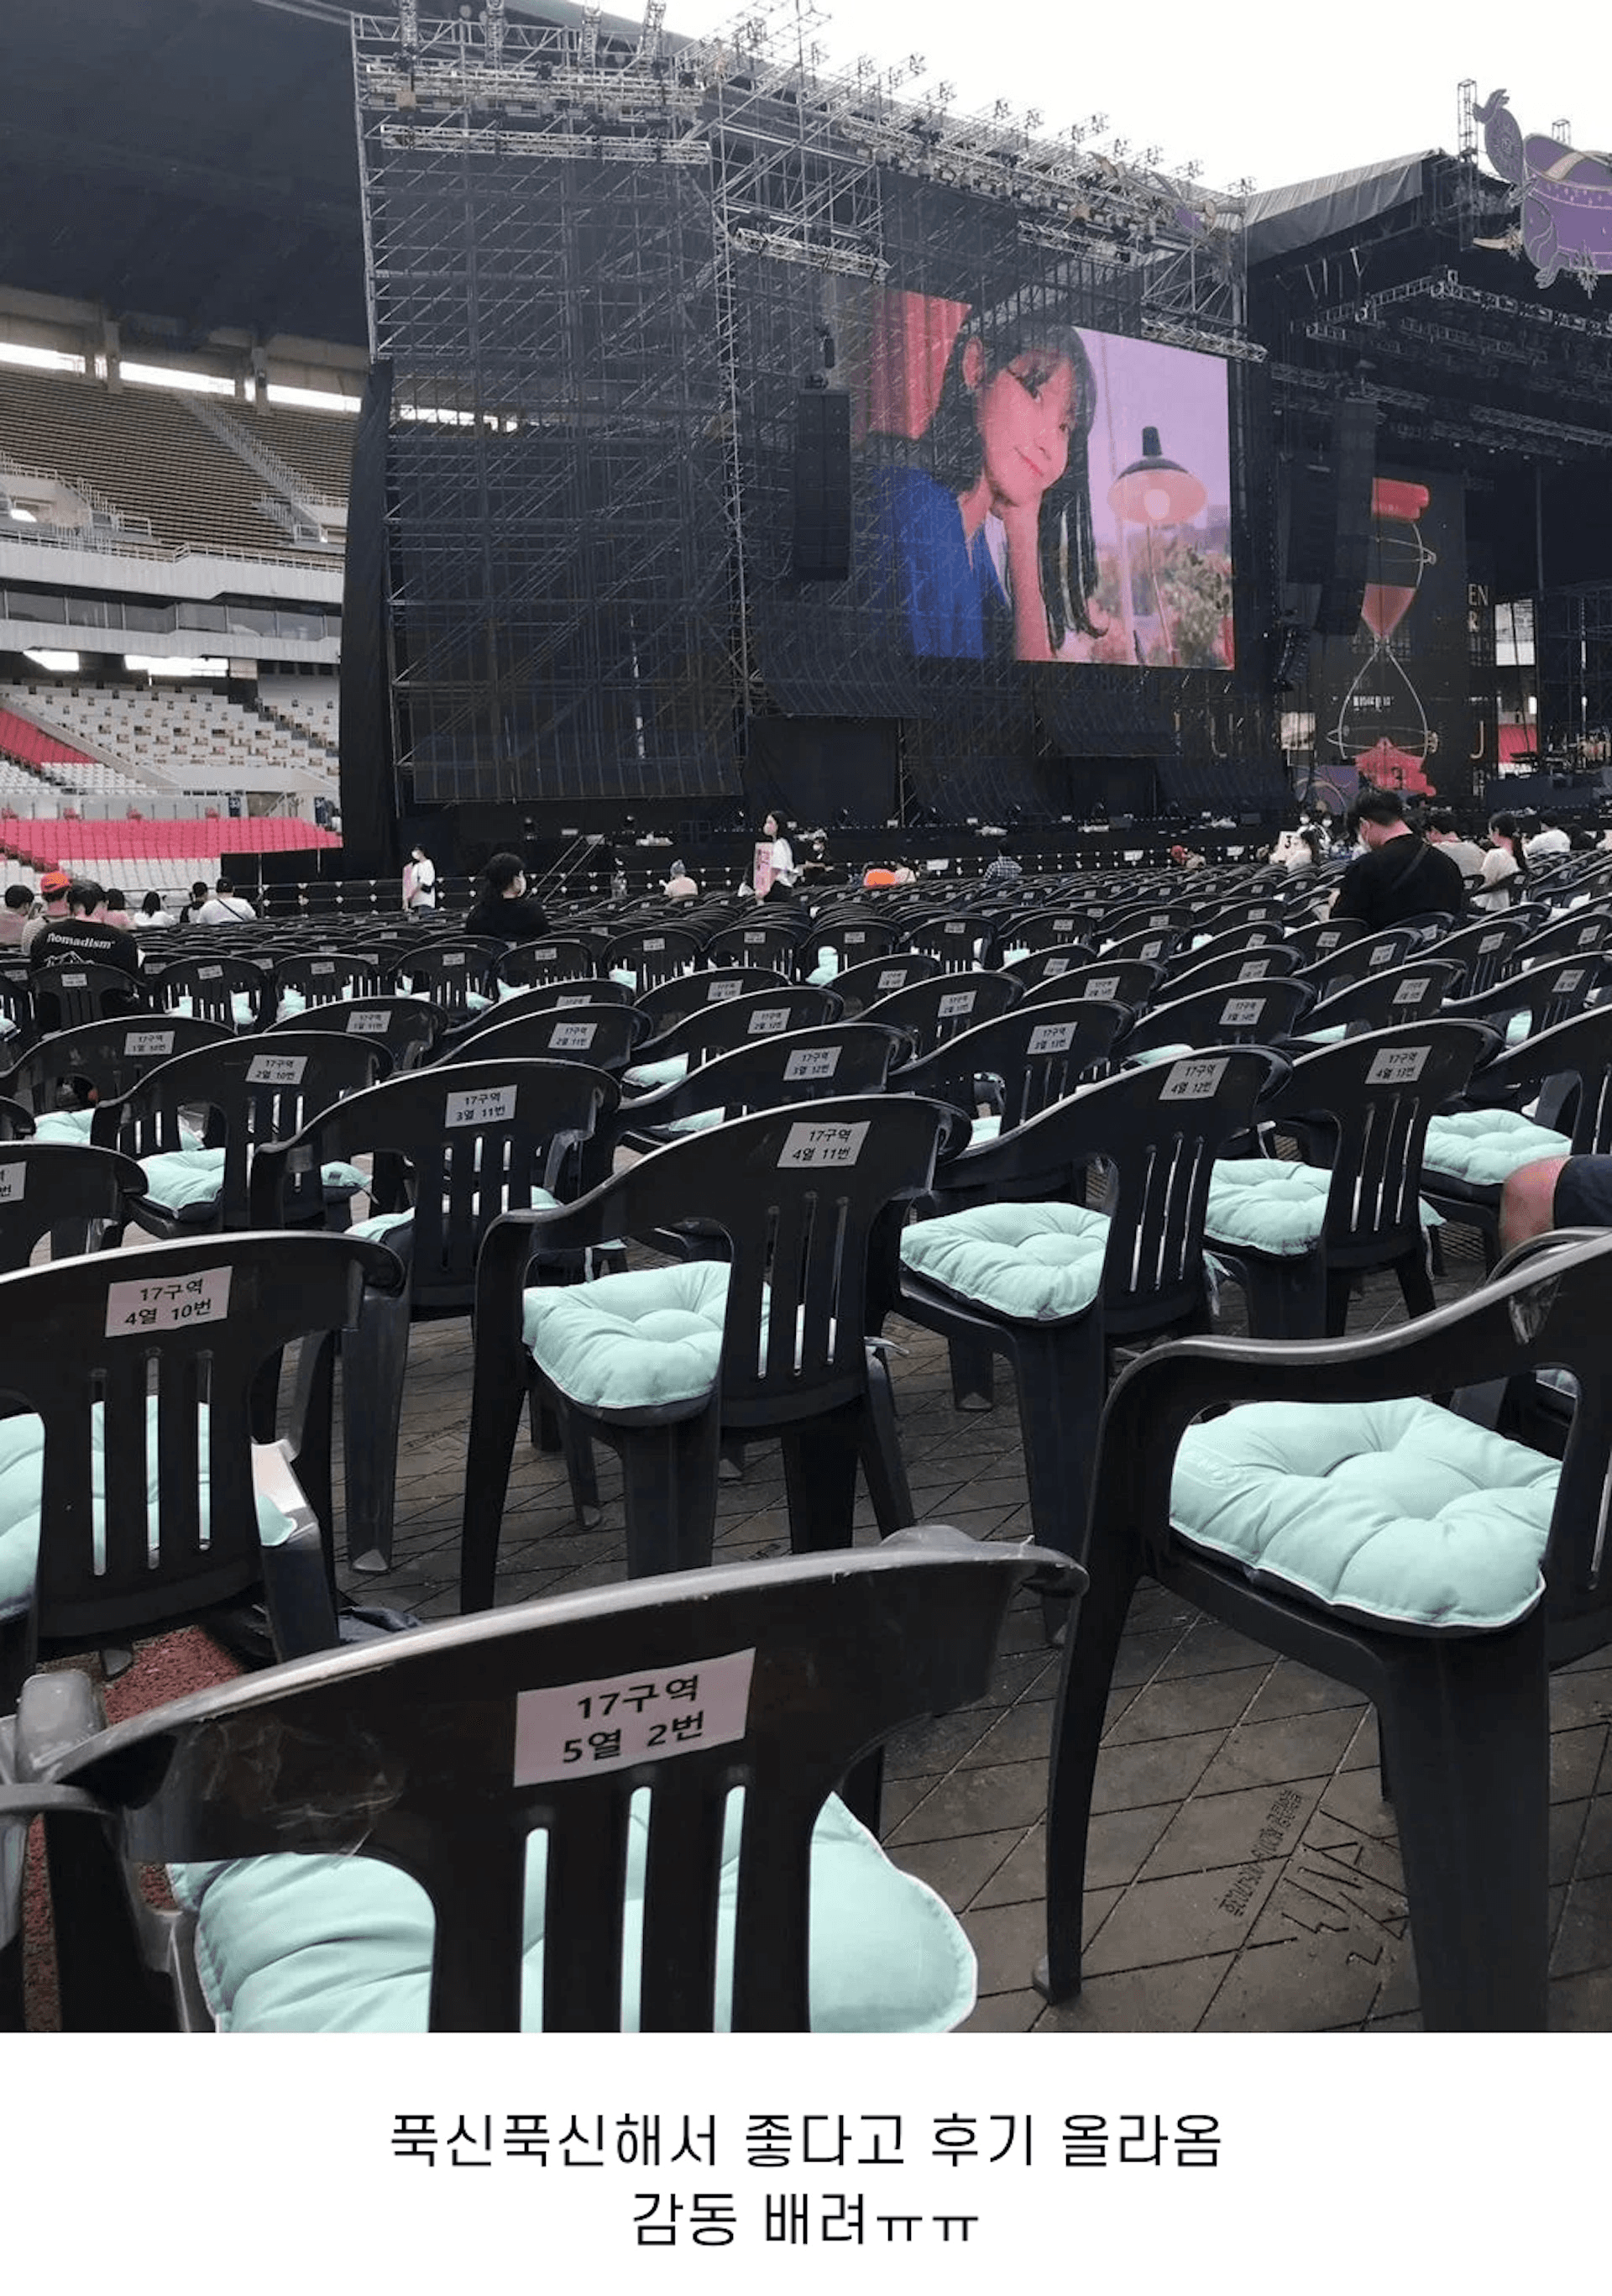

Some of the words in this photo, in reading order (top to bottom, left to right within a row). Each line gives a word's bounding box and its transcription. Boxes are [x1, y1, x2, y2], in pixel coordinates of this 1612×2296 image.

[264, 1059, 294, 1068] 17구역
[1388, 1051, 1418, 1064] 17구역
[1185, 1064, 1216, 1077] 17구역
[1170, 1081, 1189, 1094] 4열
[465, 1092, 501, 1105] 17구역
[456, 1109, 475, 1121] 3열
[482, 1104, 505, 1118] 11번
[809, 1129, 852, 1142] 17구역
[792, 1147, 816, 1161] 4열
[822, 1146, 851, 1160] 11번
[139, 1278, 203, 1301] 17구역
[124, 1308, 158, 1325] 4열
[170, 1297, 212, 1320] 10번
[578, 1675, 699, 1719] 17구역
[563, 1728, 622, 1764] 5열
[646, 1710, 704, 1748] 2번
